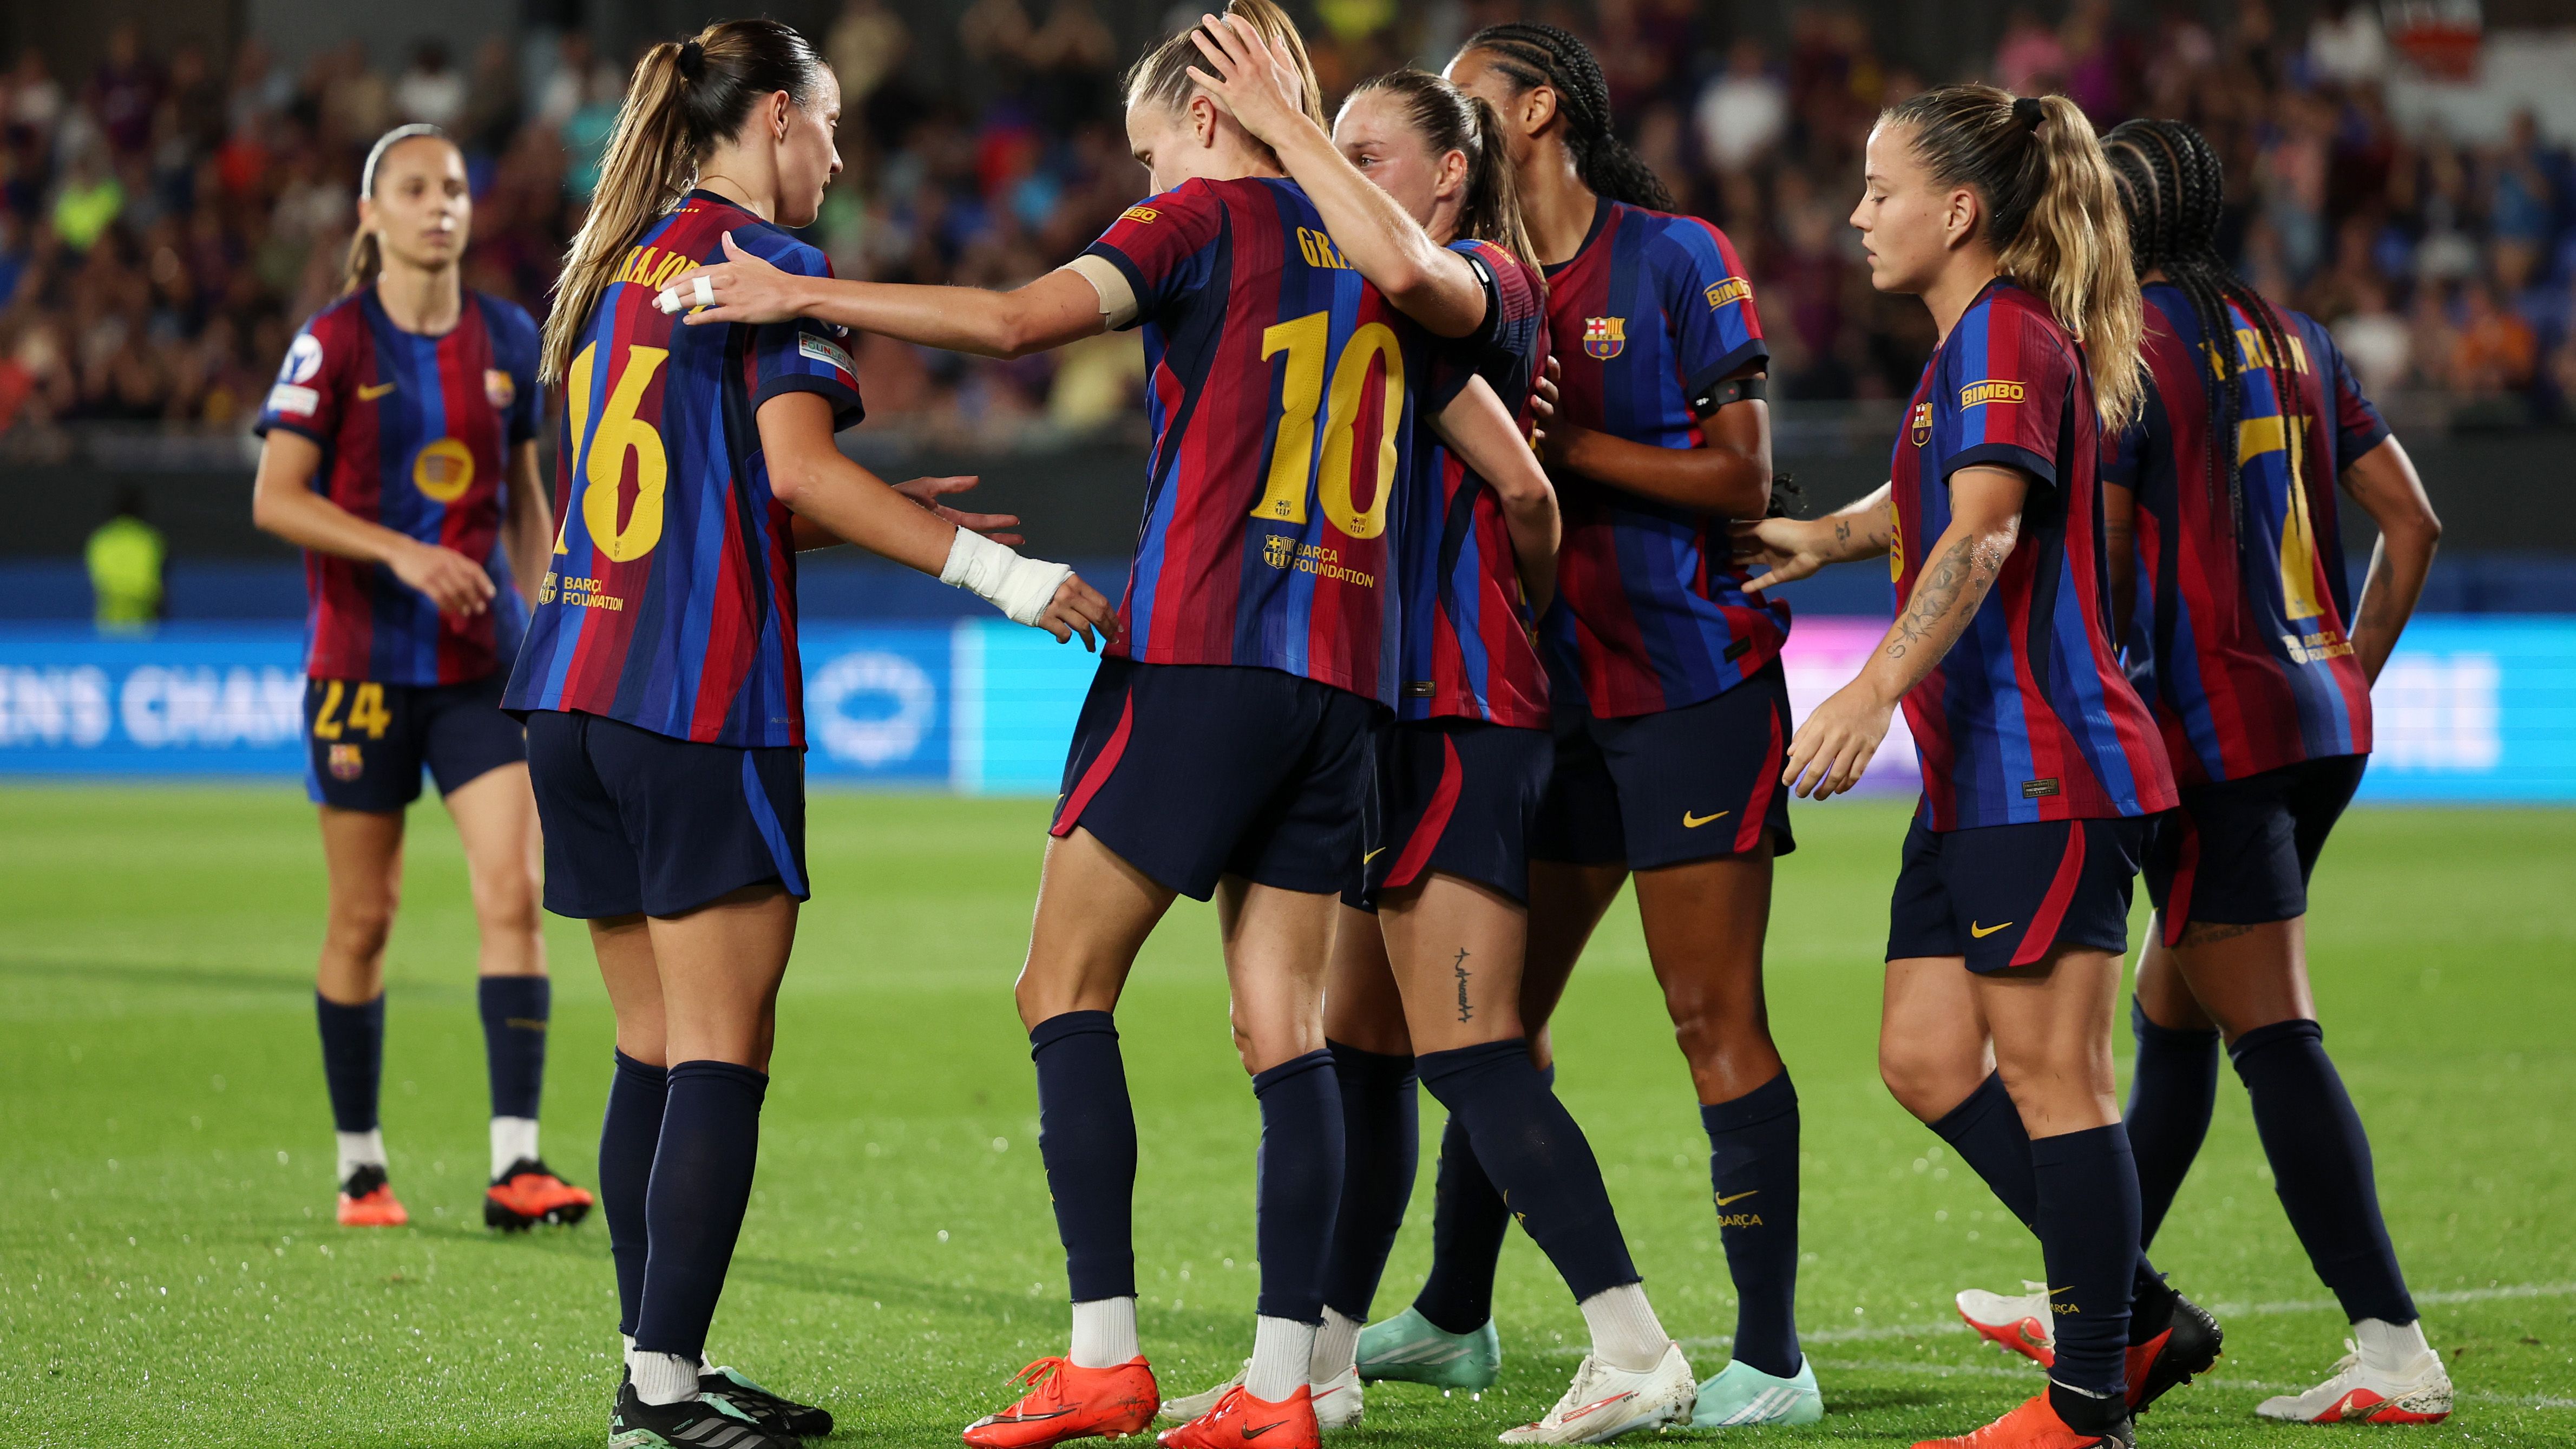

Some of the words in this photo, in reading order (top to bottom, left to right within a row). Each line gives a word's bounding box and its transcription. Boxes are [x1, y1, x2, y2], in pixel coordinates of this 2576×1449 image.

[1962, 384, 2023, 406] BIMBO
[1249, 310, 1405, 539] 10
[554, 340, 670, 562] 16
[2239, 415, 2325, 621] 7
[1296, 542, 1338, 564] BARÇA
[1293, 558, 1374, 588] FOUNDATION
[562, 591, 623, 612] FOUNATION
[314, 679, 392, 740] 24
[1717, 1214, 1763, 1228] BARÇA
